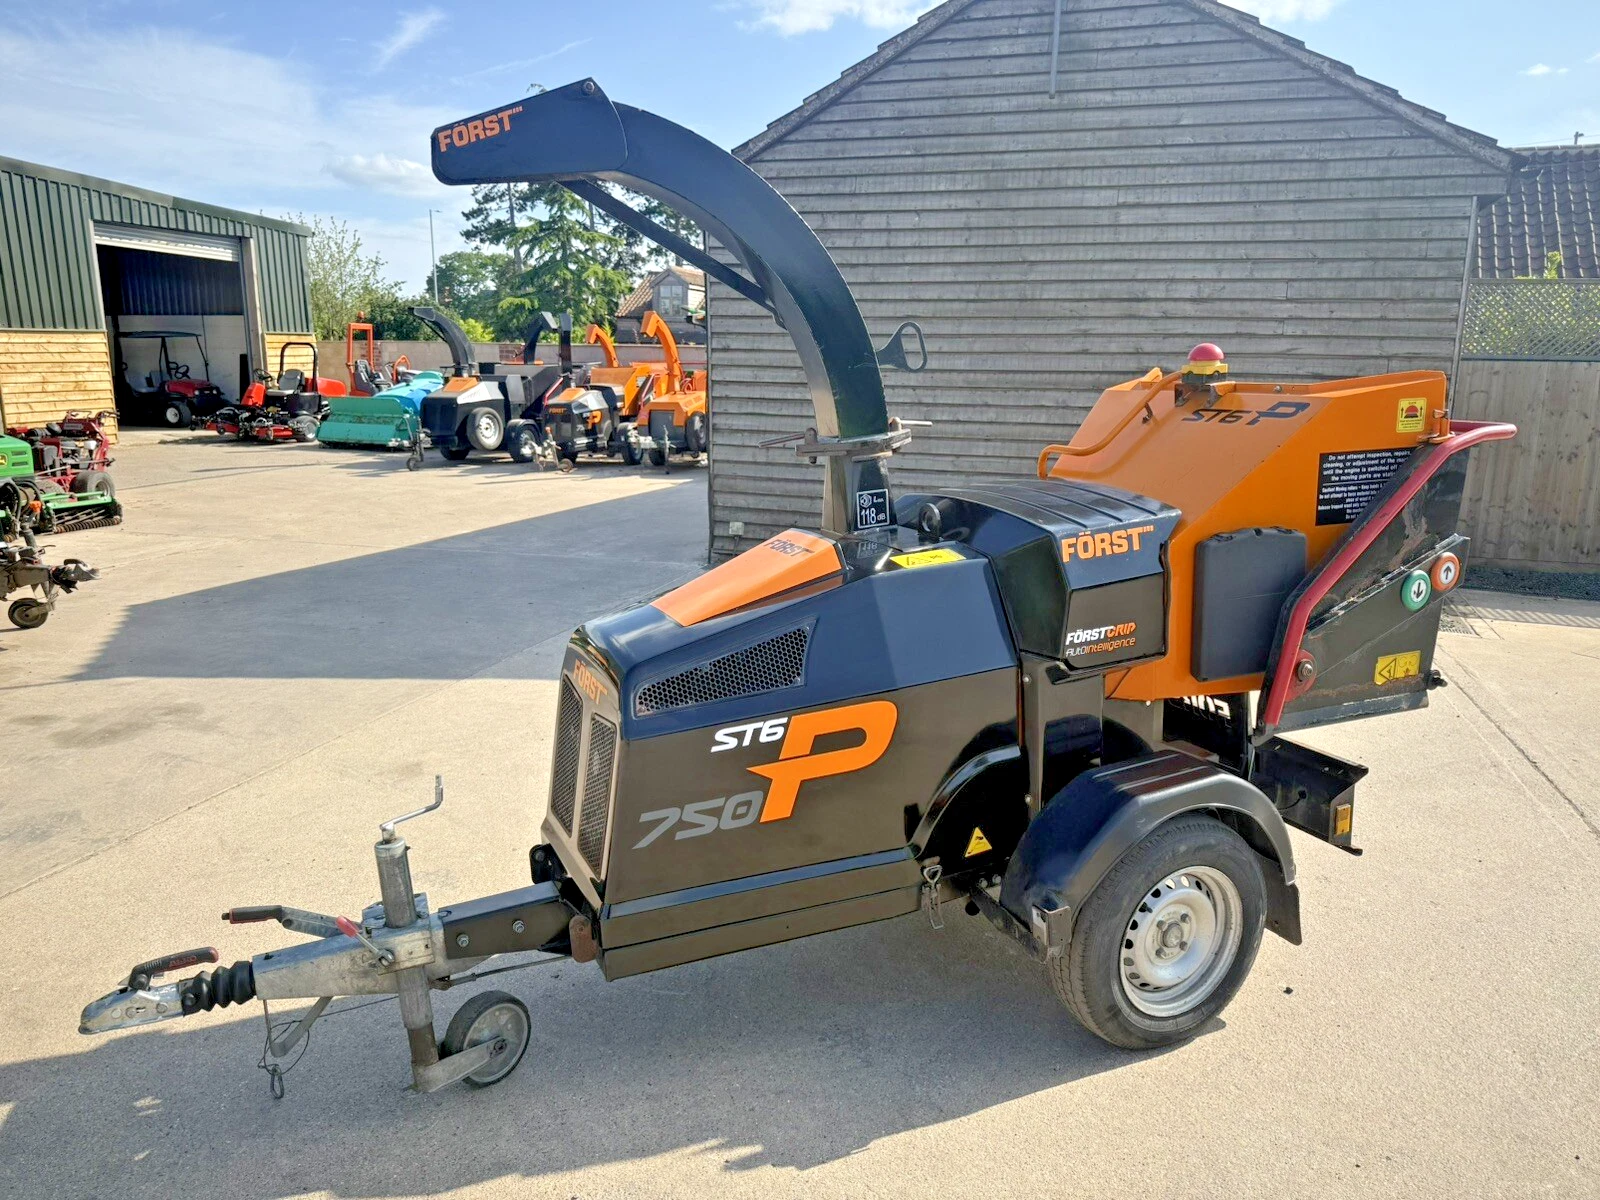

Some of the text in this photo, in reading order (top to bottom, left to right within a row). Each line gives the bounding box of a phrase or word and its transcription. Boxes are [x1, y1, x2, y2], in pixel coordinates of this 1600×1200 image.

[438, 108, 514, 152] FÖRST
[1347, 453, 1366, 461] attempt
[1352, 459, 1379, 467] adjustment
[1344, 467, 1360, 475] engine
[860, 507, 877, 525] 118
[1061, 526, 1145, 563] FÖRST
[711, 717, 788, 753] ST6
[632, 790, 764, 850] 750
